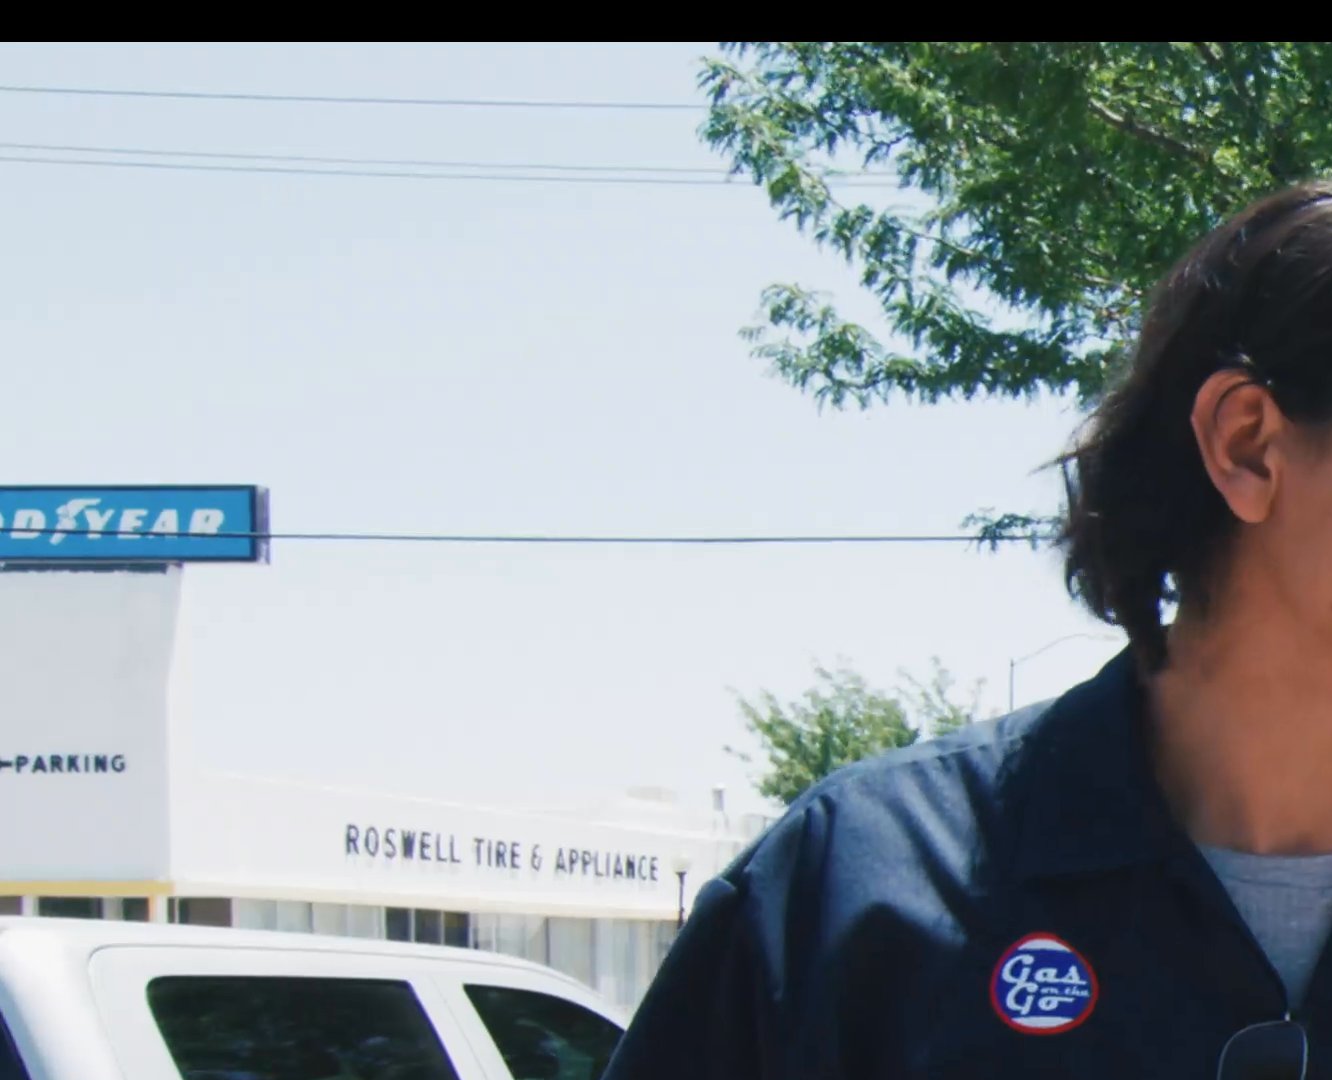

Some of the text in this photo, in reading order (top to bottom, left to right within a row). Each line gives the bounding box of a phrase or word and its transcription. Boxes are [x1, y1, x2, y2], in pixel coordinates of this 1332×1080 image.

[0, 500, 226, 544] DYEAR
[14, 754, 126, 774] PARKING
[345, 823, 659, 882] ROSWELL TIRE & APPLIANCE
[1002, 954, 1087, 986] Gas
[1006, 981, 1075, 1016] Go
